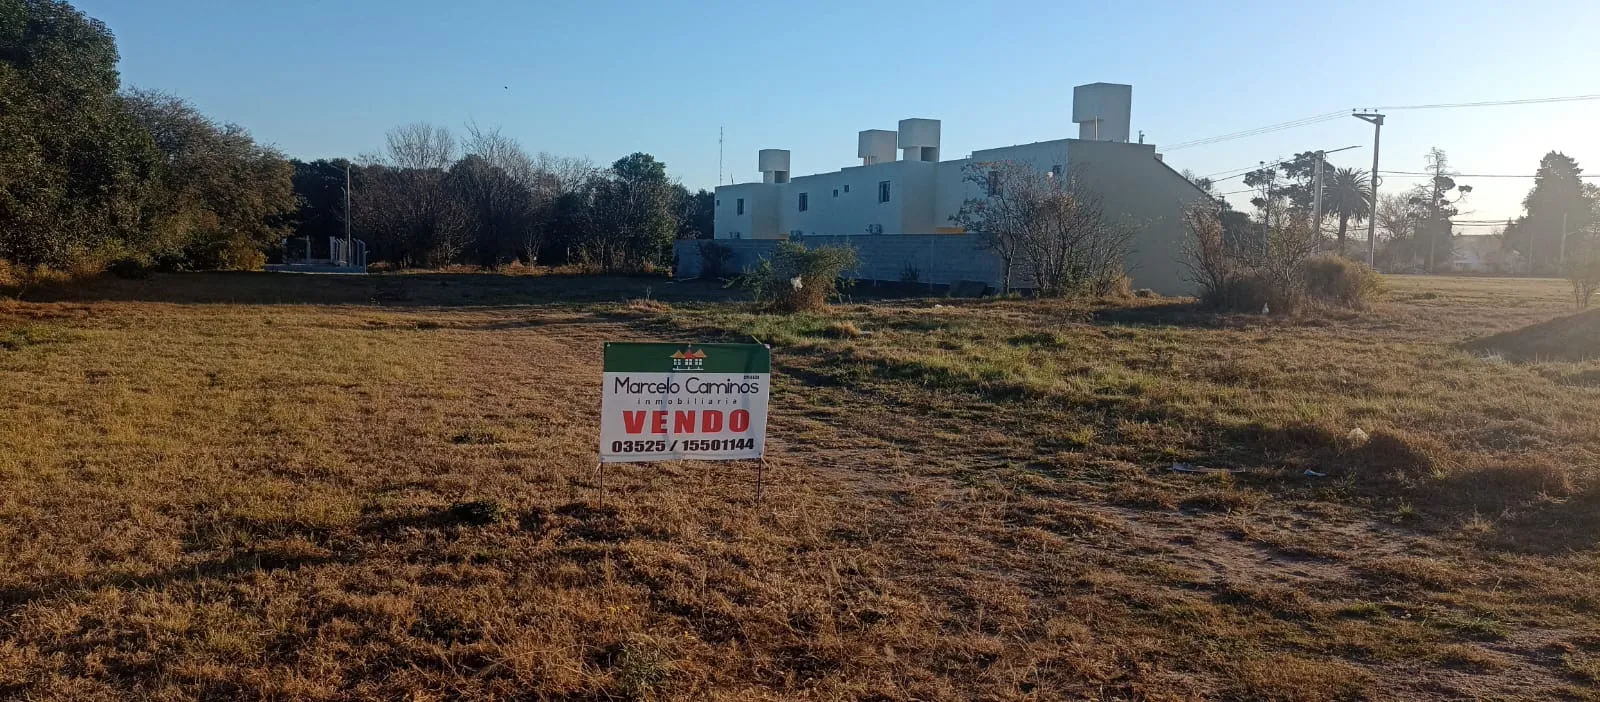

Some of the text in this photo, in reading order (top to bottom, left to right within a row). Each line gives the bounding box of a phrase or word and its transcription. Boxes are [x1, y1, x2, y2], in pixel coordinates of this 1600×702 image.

[614, 376, 759, 394] Marcelo Caminos
[637, 397, 737, 405] inmobiliaria
[622, 409, 750, 434] VENDO
[612, 438, 754, 453] 03525 / 15501144
